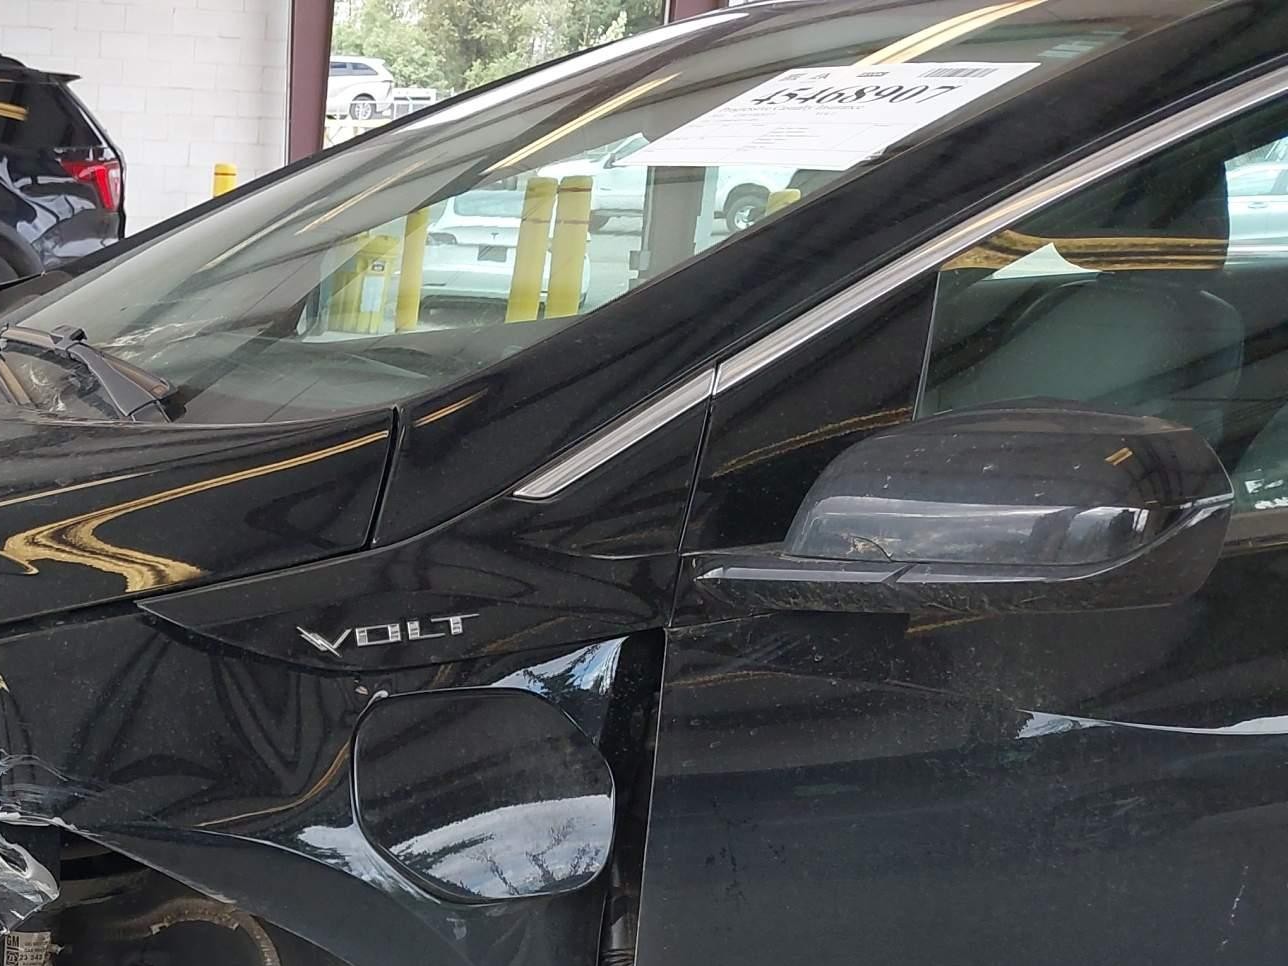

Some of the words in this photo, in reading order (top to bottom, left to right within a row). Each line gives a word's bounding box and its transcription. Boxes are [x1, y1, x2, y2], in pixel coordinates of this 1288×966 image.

[751, 85, 962, 105] 45468907
[296, 613, 481, 657] VOLT
[7, 935, 19, 947] GM
